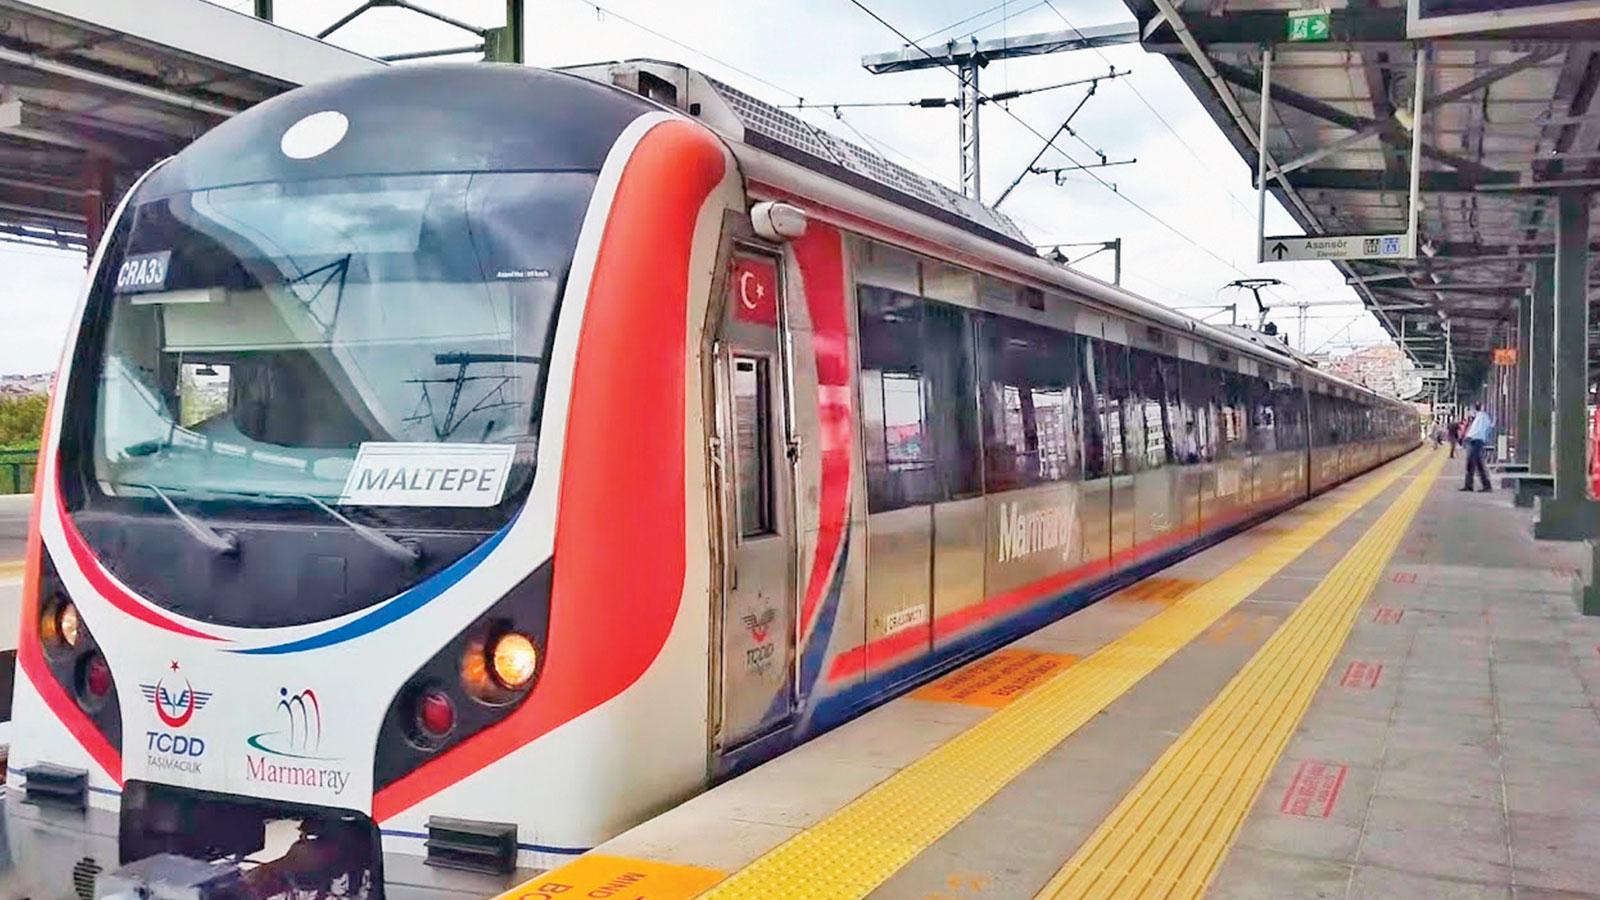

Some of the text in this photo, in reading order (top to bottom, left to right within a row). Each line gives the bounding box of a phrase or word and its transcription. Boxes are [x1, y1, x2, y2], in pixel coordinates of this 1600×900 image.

[1305, 239, 1348, 250] Asansör
[356, 467, 497, 492] MALTEPE
[146, 731, 205, 757] TCDD
[245, 754, 351, 796] Marmaray
[587, 871, 648, 899] MIND
